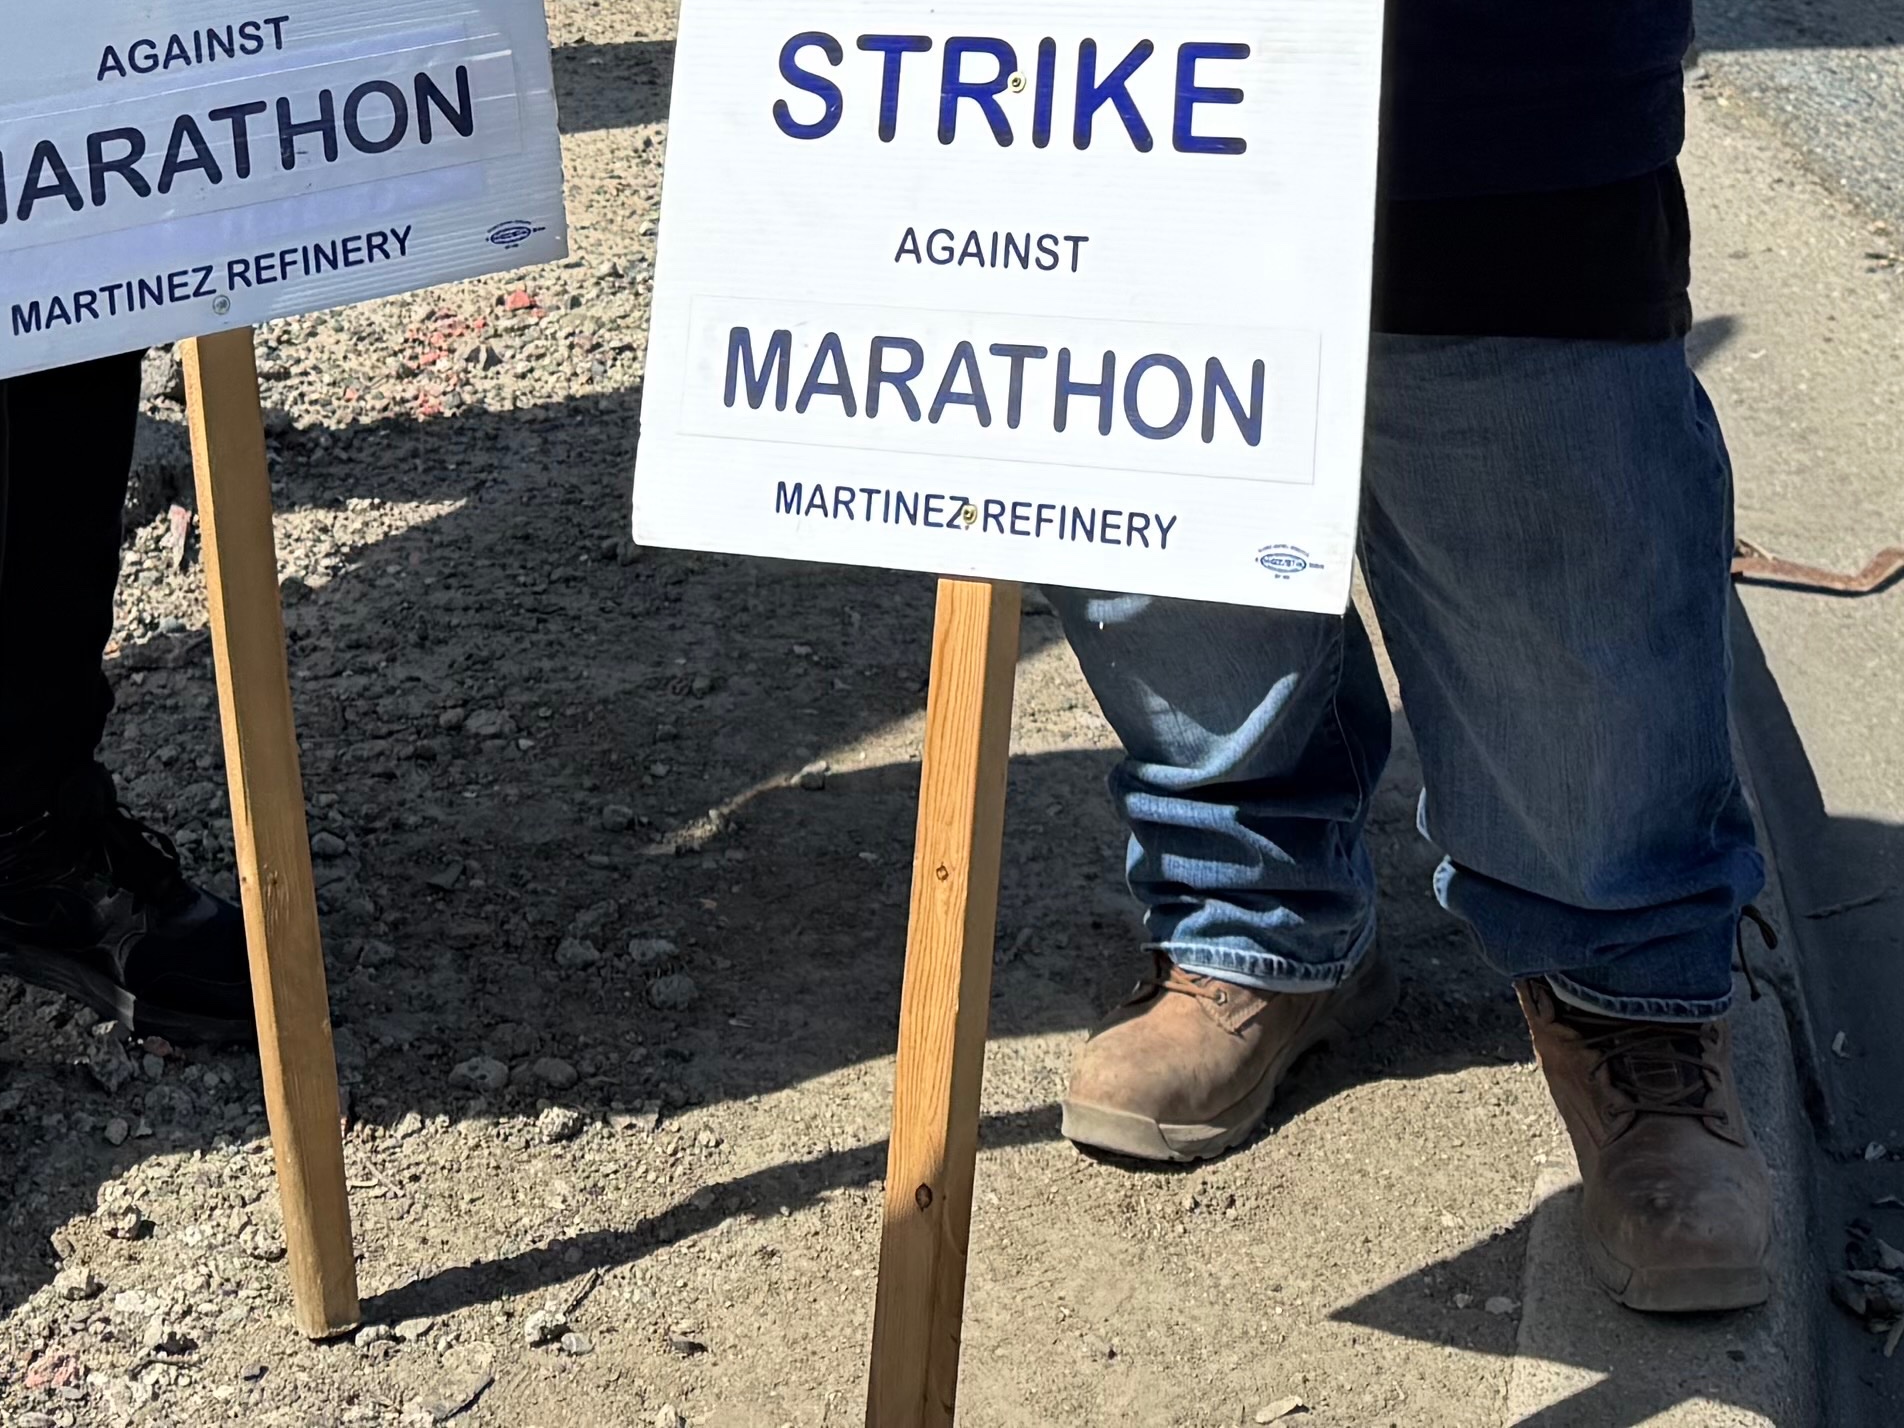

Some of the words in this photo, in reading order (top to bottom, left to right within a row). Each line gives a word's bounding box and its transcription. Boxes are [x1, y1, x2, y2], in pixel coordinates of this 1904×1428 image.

[95, 14, 291, 82] AGAINST
[771, 30, 1252, 156] STRIKE
[9, 263, 217, 338] MARTINEZ
[226, 224, 413, 293] REFINERY
[893, 226, 1090, 274] AGAINST
[722, 326, 1266, 448] MARATHON
[774, 480, 970, 532] MARTINEZ
[981, 498, 1179, 551] REFINERY
